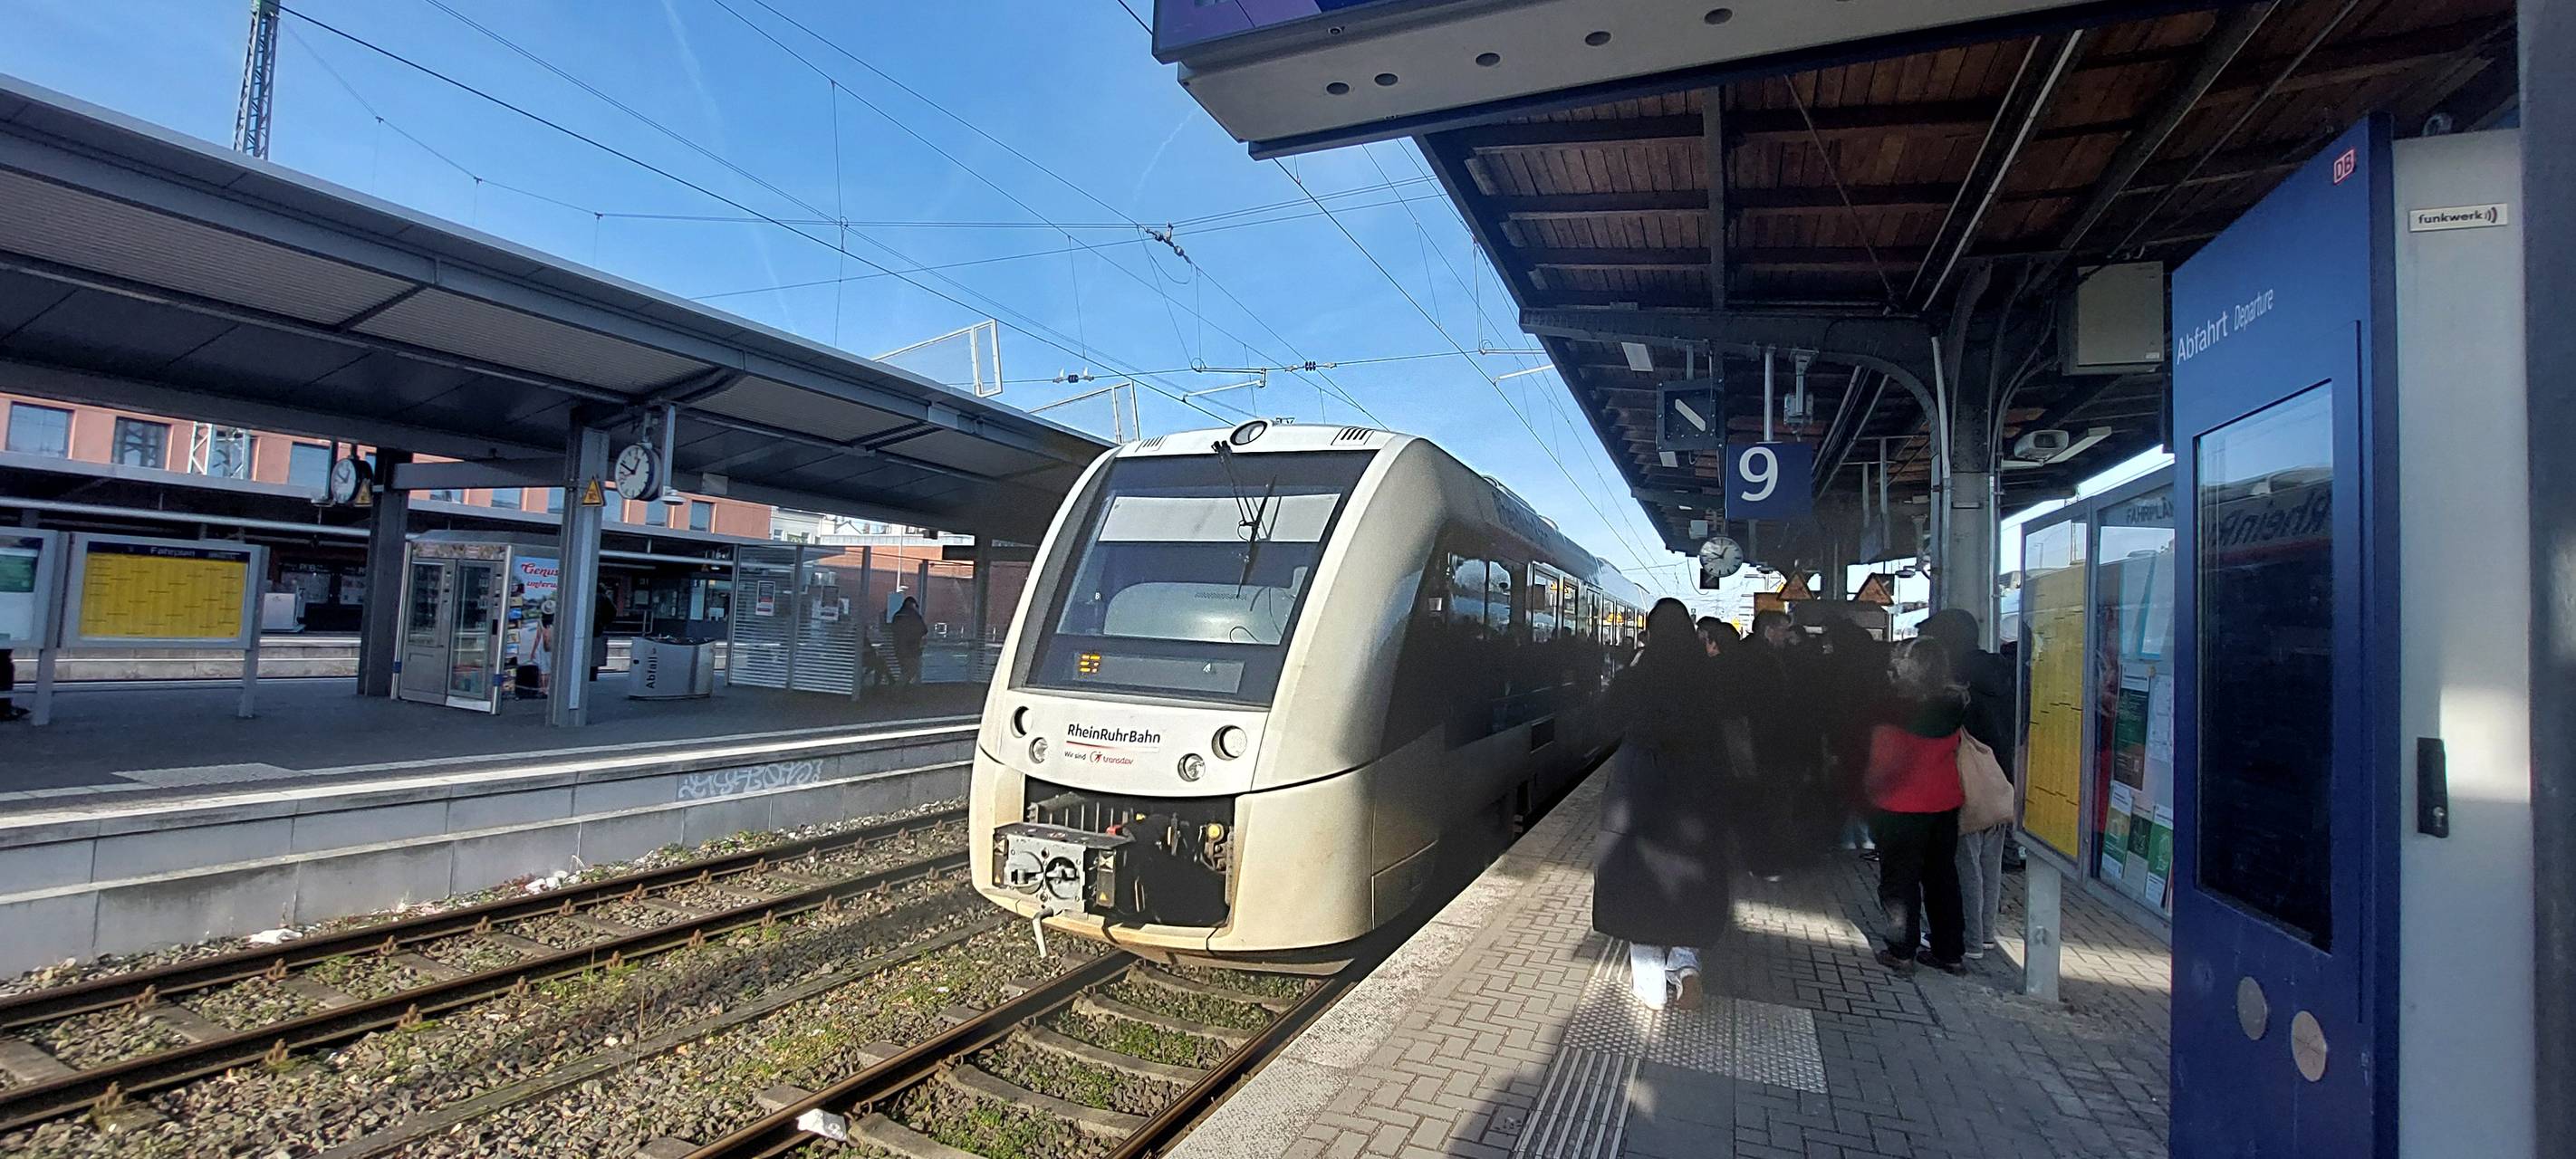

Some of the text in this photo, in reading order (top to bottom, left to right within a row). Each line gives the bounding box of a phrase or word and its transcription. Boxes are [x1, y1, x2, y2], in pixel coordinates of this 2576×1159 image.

[2334, 151, 2354, 182] DB
[2417, 209, 2484, 225] funkwerk
[2177, 289, 2273, 366] Abfahrt Departure
[1739, 446, 1778, 502] 9
[646, 656, 658, 689] Abfall
[1067, 723, 1161, 743] RheinRuhrBahn
